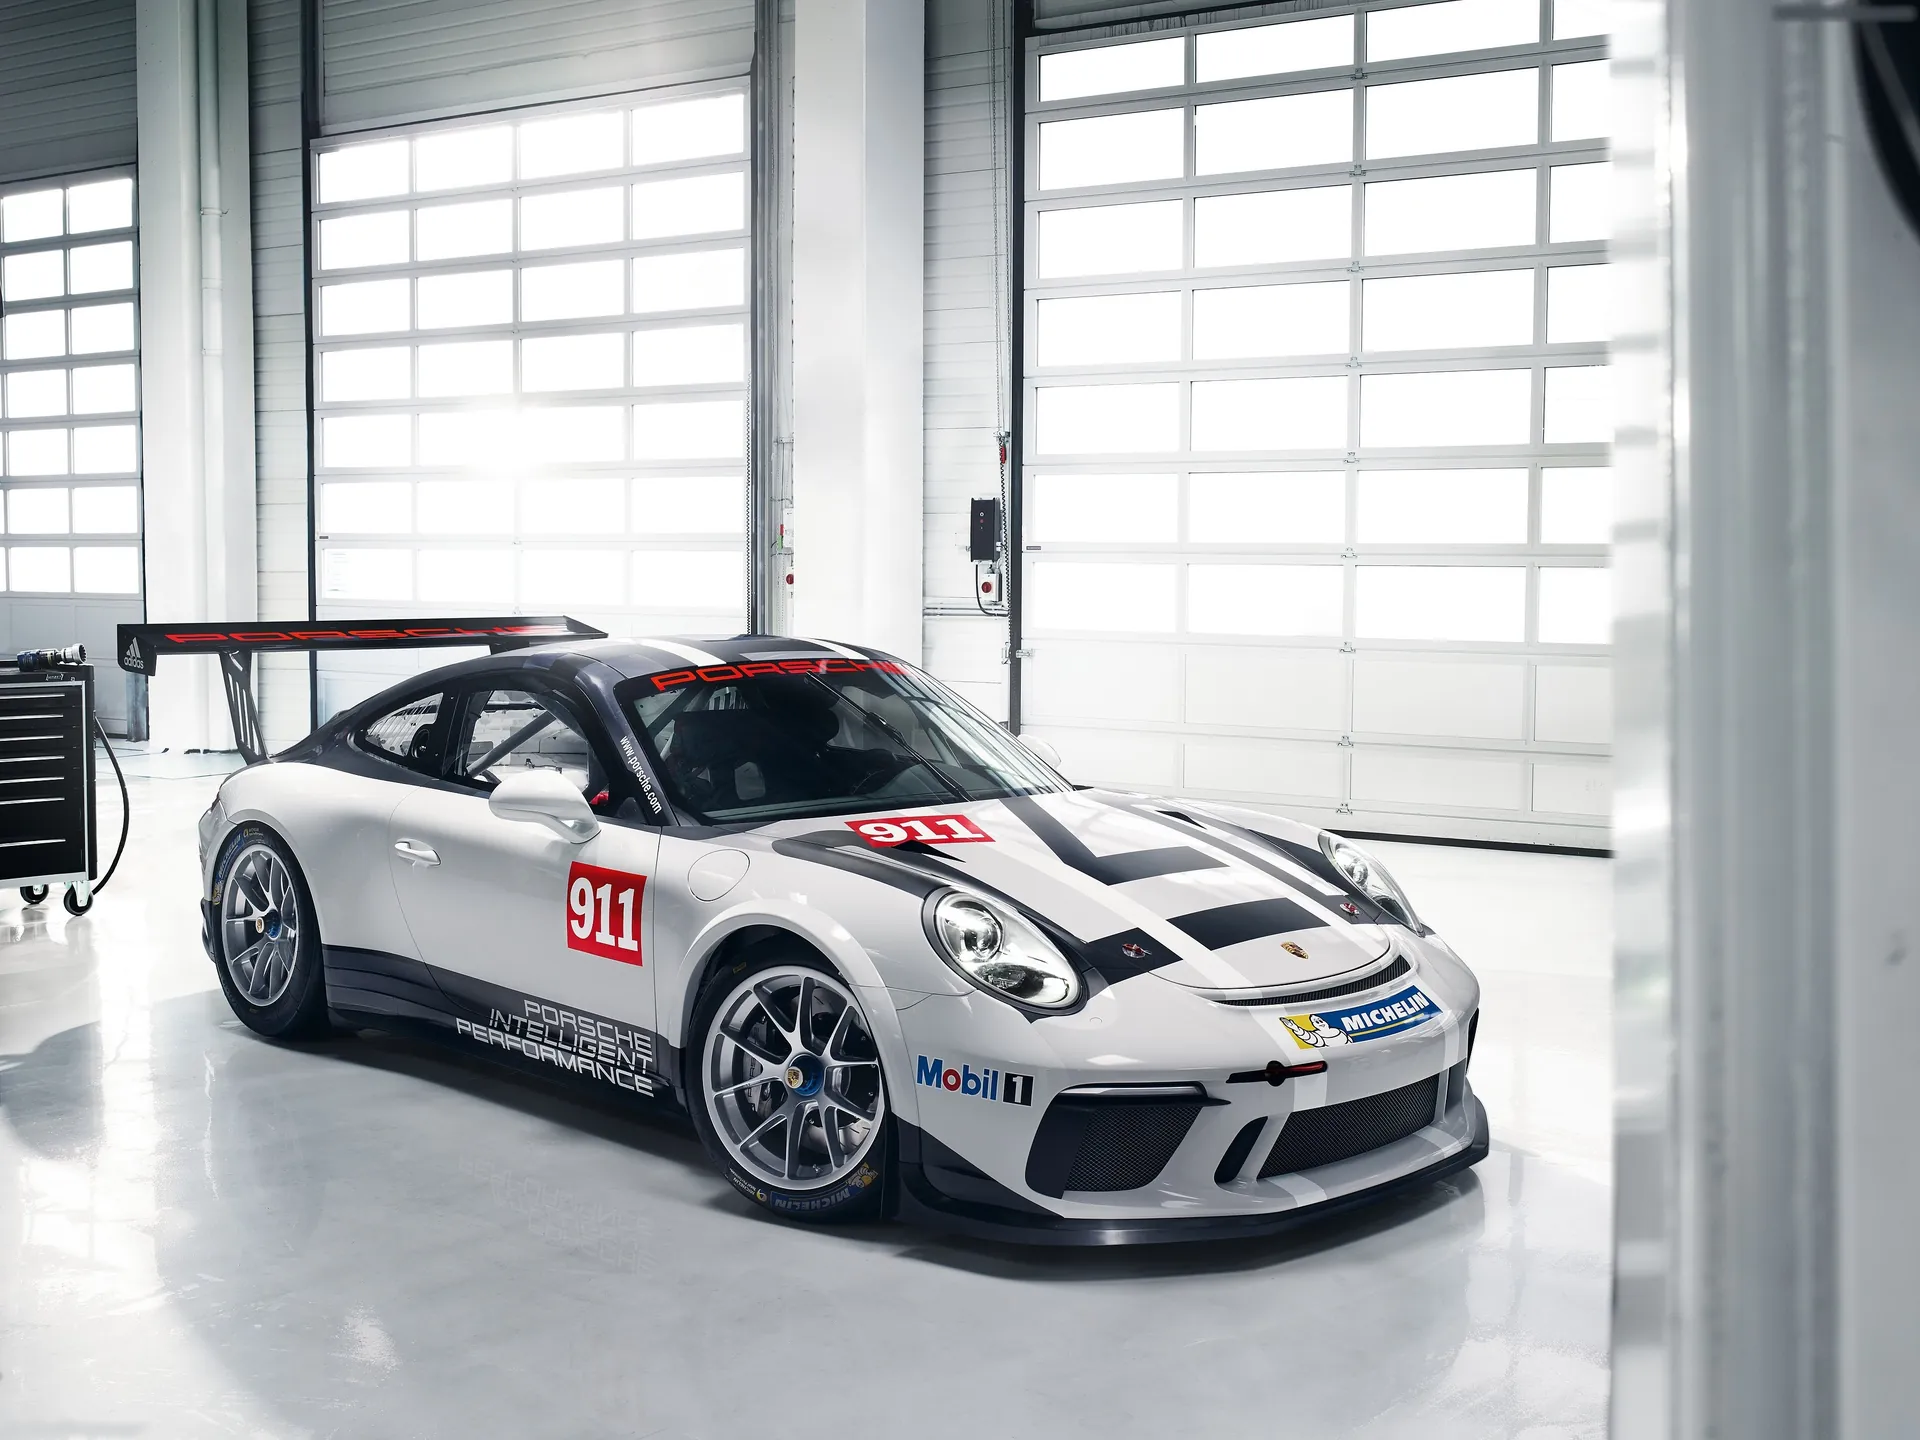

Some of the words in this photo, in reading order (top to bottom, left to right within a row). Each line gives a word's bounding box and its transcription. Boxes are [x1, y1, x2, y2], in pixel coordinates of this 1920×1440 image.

[165, 625, 557, 643] PORSCHE
[124, 656, 144, 670] adidas
[651, 659, 910, 691] PORSCHE
[619, 735, 662, 815] www.porsche.com
[858, 819, 987, 842] 911
[570, 877, 638, 951] 911
[524, 1000, 653, 1056] PORSCHE
[1341, 991, 1431, 1031] MICHELIN
[455, 1018, 654, 1097] PERFORMANCE
[489, 1008, 653, 1075] INTELLIGENT
[917, 1057, 998, 1101] Mobil
[1010, 1075, 1025, 1104] 1
[774, 1187, 850, 1211] MICHELIN
